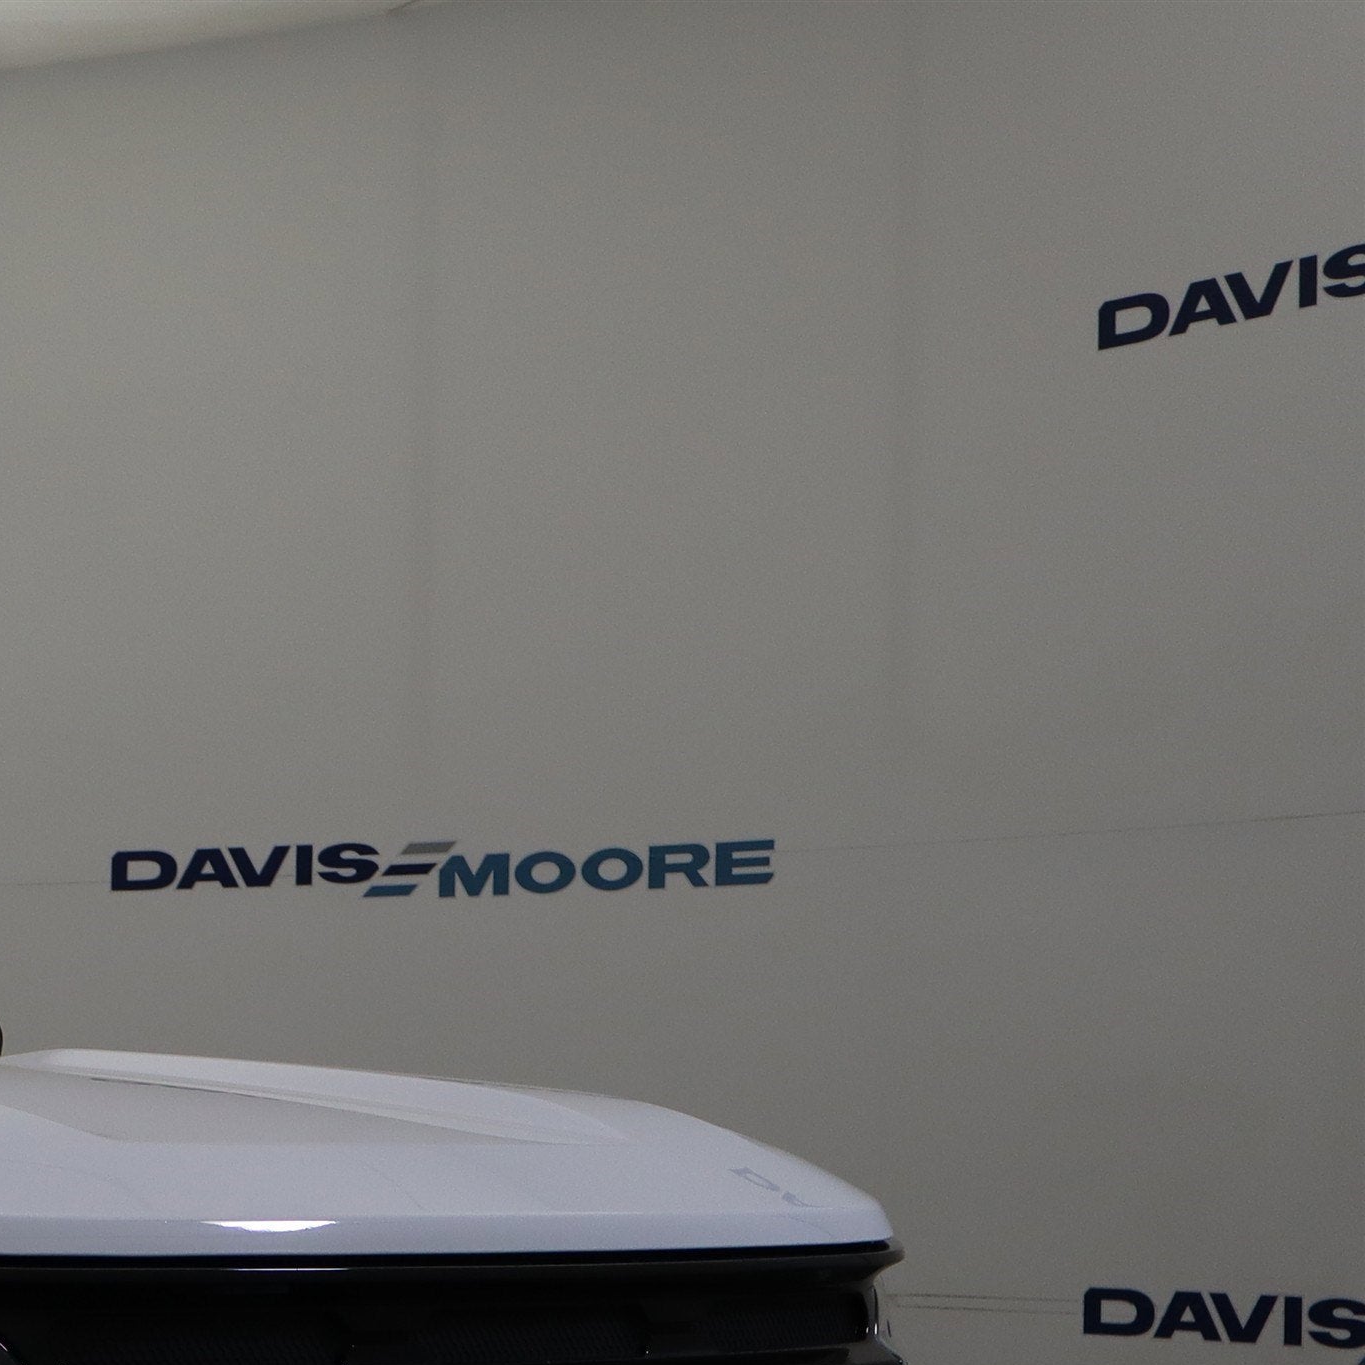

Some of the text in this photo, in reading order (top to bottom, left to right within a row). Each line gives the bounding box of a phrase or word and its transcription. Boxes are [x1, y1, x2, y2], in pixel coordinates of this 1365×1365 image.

[110, 838, 775, 897] DAVIS MOORE
[1083, 1287, 1365, 1349] DAVIS
